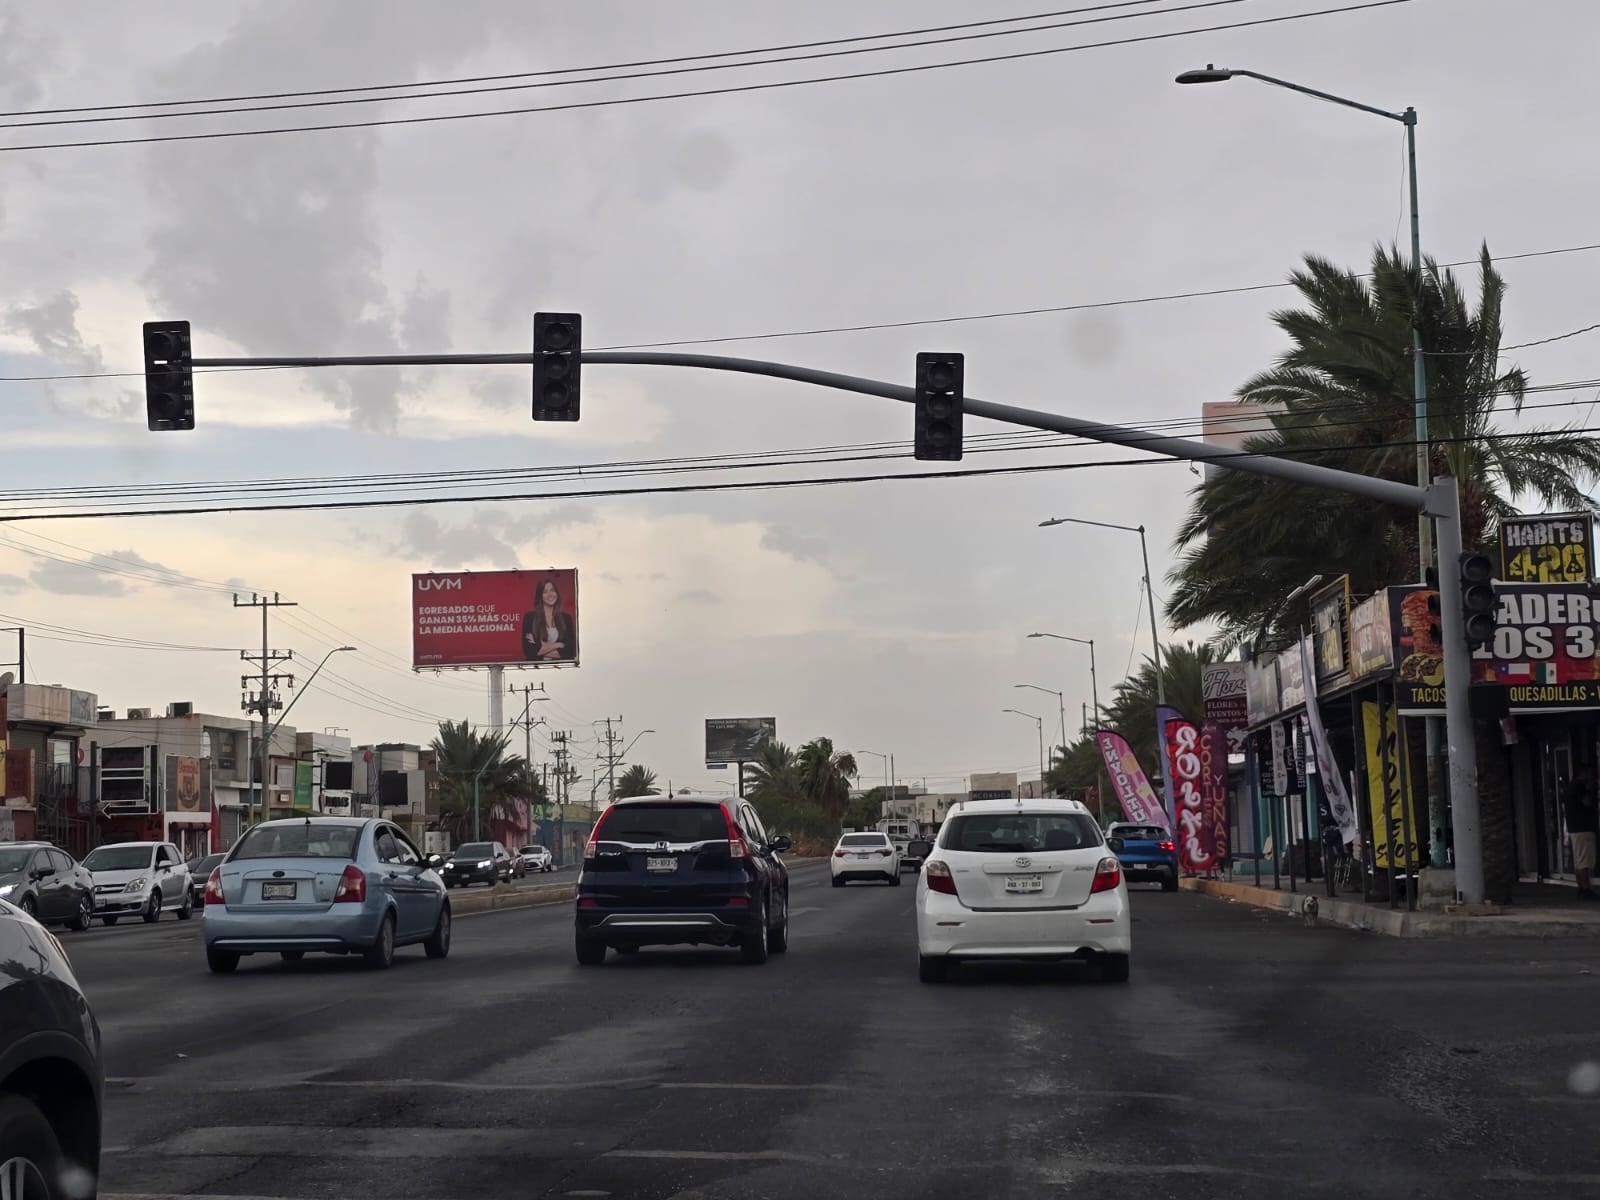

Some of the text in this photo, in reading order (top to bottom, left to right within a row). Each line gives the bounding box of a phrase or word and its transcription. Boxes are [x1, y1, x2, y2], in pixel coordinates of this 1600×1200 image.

[1506, 522, 1584, 547] HABITS
[1509, 544, 1586, 582] 420
[418, 578, 462, 591] UVM
[419, 604, 496, 615] EGRESADOS QUE
[1493, 593, 1600, 625] ADER
[419, 612, 520, 625] GANAN 35% MÁS QUE
[419, 623, 515, 635] LA MEDIA NACIONAL
[1565, 625, 1594, 659] 3
[1411, 687, 1447, 703] TACOS
[1509, 686, 1586, 702] QUESADILLAS
[1213, 774, 1223, 786] Y
